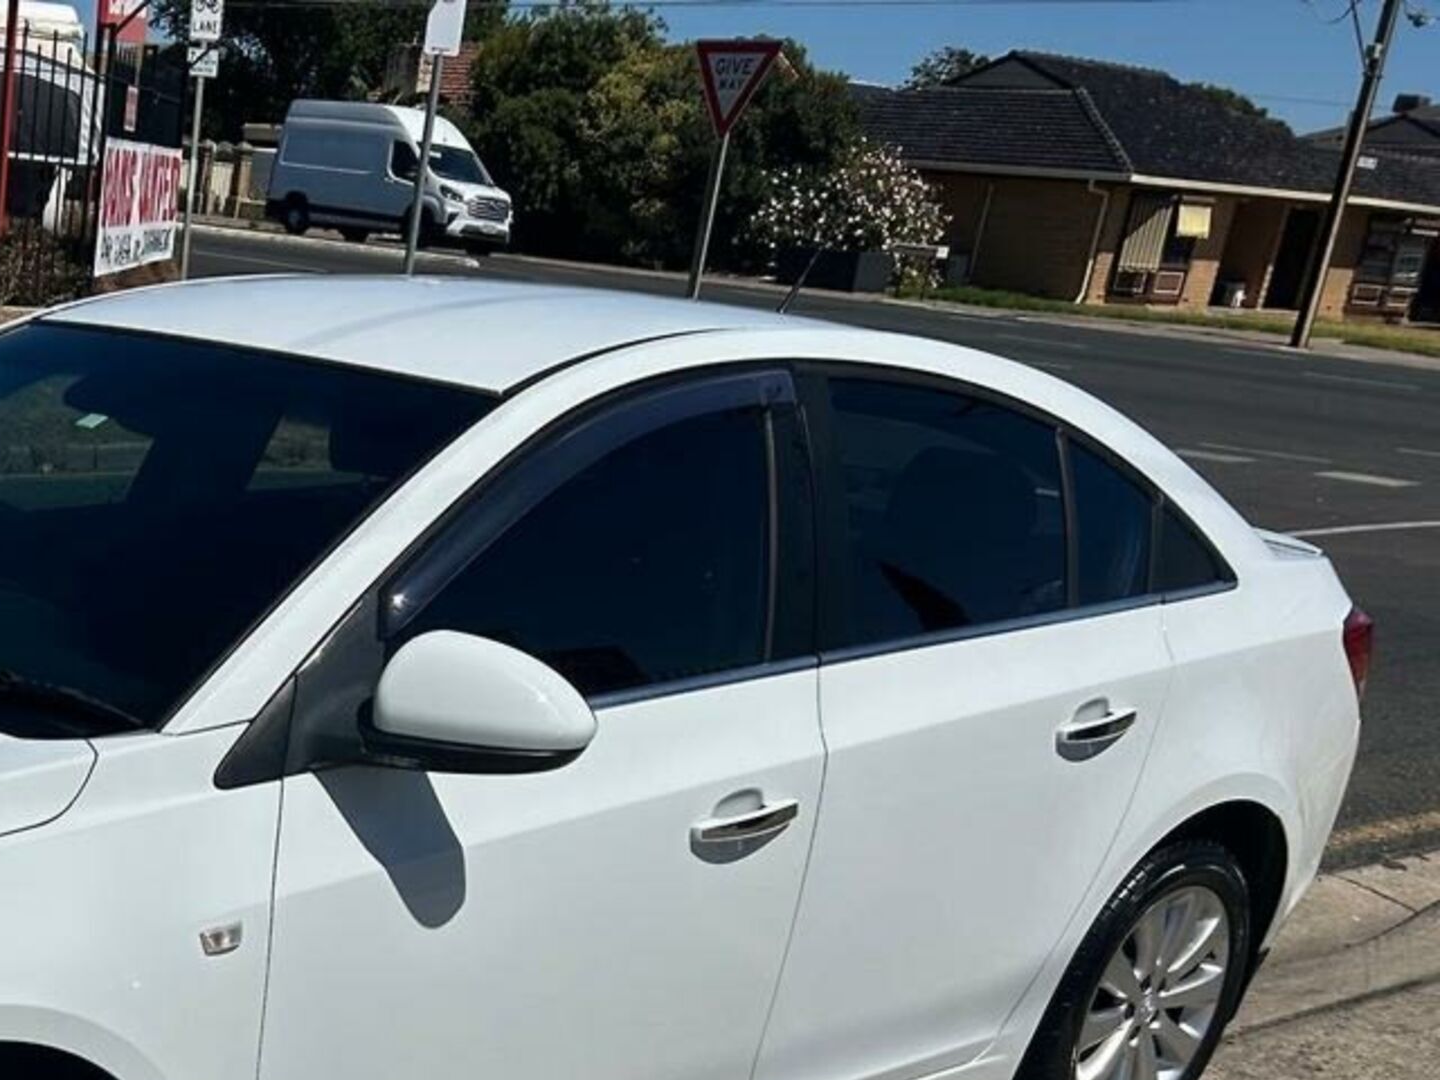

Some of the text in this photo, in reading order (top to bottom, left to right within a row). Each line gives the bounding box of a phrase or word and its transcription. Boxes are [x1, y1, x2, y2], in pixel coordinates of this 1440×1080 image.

[193, 20, 218, 34] LANE
[715, 57, 754, 76] GIVE
[719, 77, 746, 90] WAY
